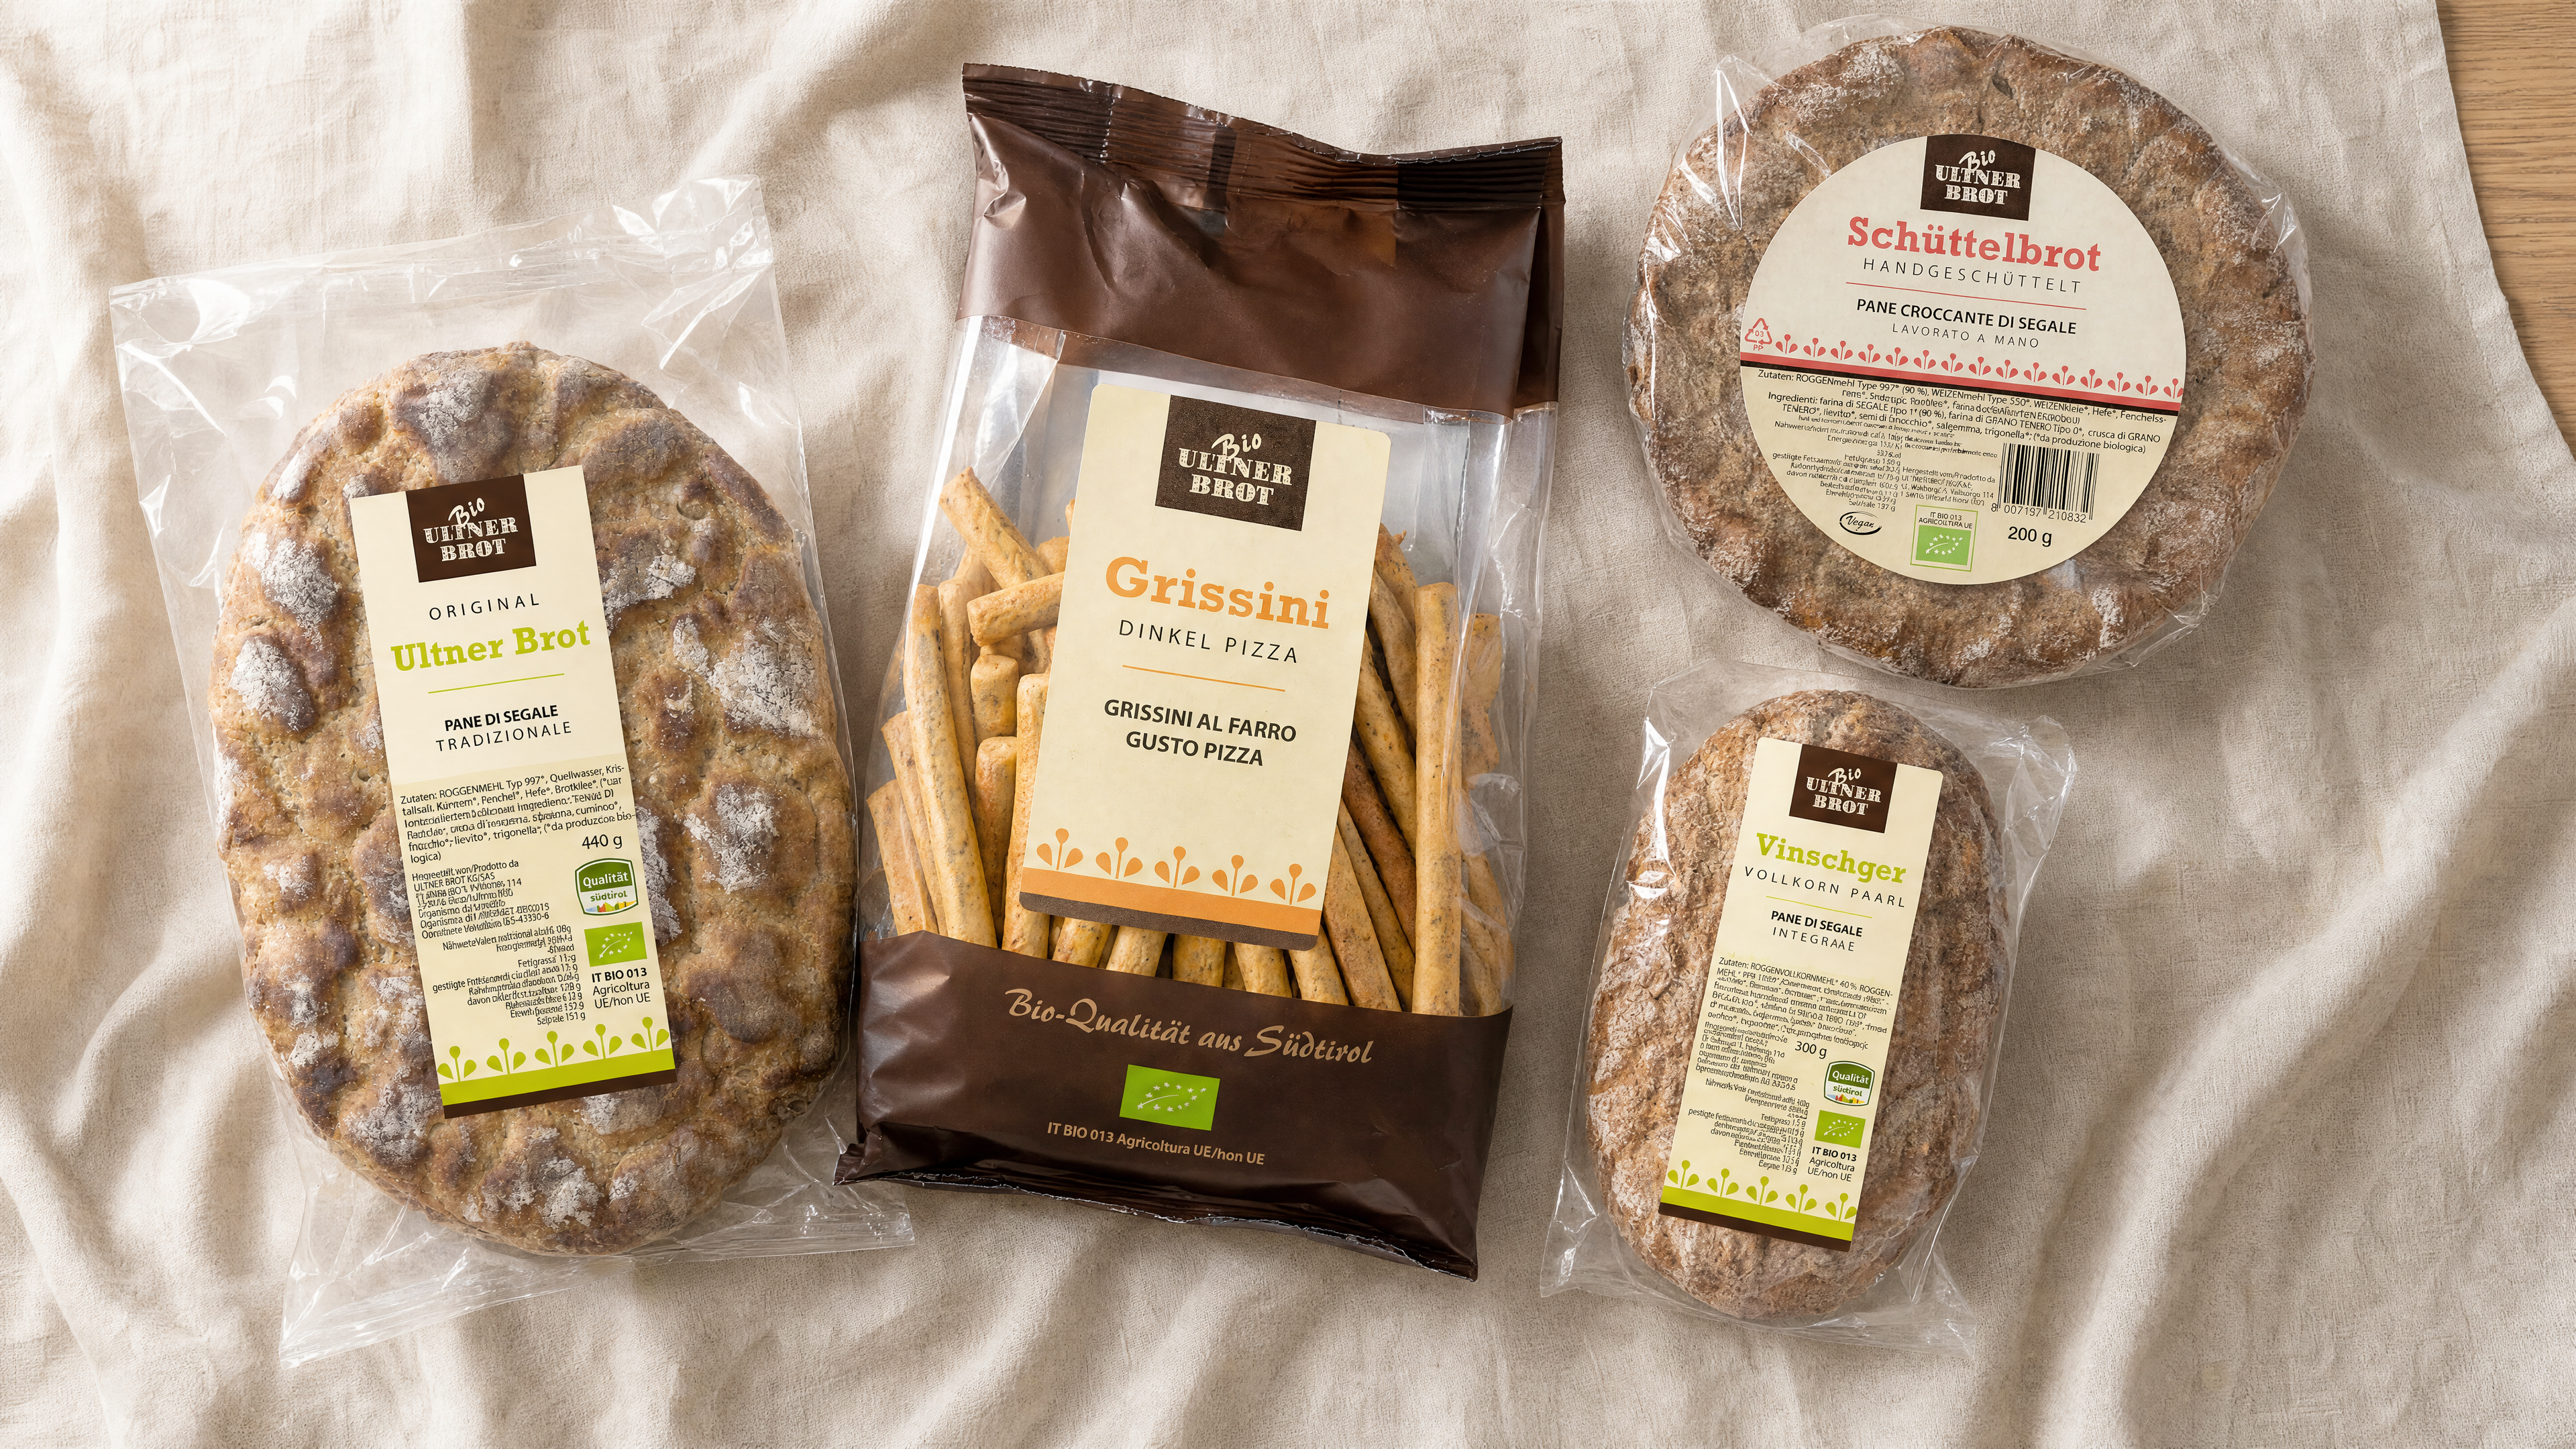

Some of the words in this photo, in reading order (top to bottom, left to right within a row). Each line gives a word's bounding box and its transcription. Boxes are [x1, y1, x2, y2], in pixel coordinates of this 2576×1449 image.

[1959, 150, 1996, 171] Bio
[1935, 164, 2021, 190] ULTNER
[1944, 184, 2008, 205] BROT
[1847, 216, 2101, 272] Schüttelbrot
[1864, 258, 2081, 293] HANDGESCHÜTTELT
[1857, 299, 1897, 315] PANE
[1900, 304, 1994, 327] CROCCANTE
[1998, 315, 2015, 328] DI
[2019, 317, 2077, 335] SEGALE
[1892, 323, 1970, 341] LAVORATO
[1977, 333, 1985, 343] A
[1994, 335, 2039, 348] MANO
[1758, 369, 1794, 381] Zutaten:
[1796, 374, 1855, 387] ROGGENmehl
[1857, 380, 1878, 391] Type
[1931, 388, 1986, 401] WEIZENmehl
[1987, 394, 2007, 405] Type
[1768, 391, 1818, 404] Ingredienti:
[1820, 396, 1843, 407] farina
[1845, 399, 1854, 408] di
[1856, 400, 1888, 411] SEGALE
[1948, 411, 1973, 421] farina
[1975, 415, 1984, 423] di
[2019, 419, 2052, 431] TENERO
[2053, 423, 2071, 435] Tipo
[2088, 430, 2115, 439] crusca
[2117, 431, 2126, 440] di
[2128, 432, 2161, 443] GRANO
[1212, 433, 1262, 460] Bio
[1859, 413, 1878, 421] semi
[1879, 413, 1887, 422] di
[2051, 437, 2101, 449] produzione
[2103, 440, 2146, 454] biologica)
[1179, 447, 1293, 486] ULTNER
[1189, 474, 1275, 506] BROT
[448, 497, 485, 527] Bio
[2048, 509, 2086, 523] 210832
[423, 517, 518, 543] ULTNER
[2008, 526, 2037, 542] 200
[2042, 532, 2052, 547] g
[441, 539, 506, 561] BROT
[1106, 556, 1330, 630] Grissini
[429, 593, 539, 621] ORIGINAL
[390, 639, 504, 672] Ultner
[512, 620, 591, 655] Brot
[1119, 619, 1210, 650] DINKEL
[1225, 637, 1297, 663] PIZZA
[444, 715, 482, 732] PANE
[484, 712, 501, 726] DI
[503, 704, 559, 723] SEGALE
[1104, 699, 1193, 728] GRISSINI
[1196, 713, 1223, 733] AL
[1228, 717, 1297, 742] FARRO
[435, 721, 572, 751] TRADIZIONALE
[1126, 731, 1199, 757] GUSTO
[1203, 742, 1263, 767] PIZZA
[400, 793, 437, 804] Zutaten:
[439, 782, 504, 798] ROGGENMEHL
[505, 780, 523, 791] Typ
[549, 768, 604, 783] Quellwasser,
[606, 764, 625, 774] Kris-
[1828, 767, 1862, 785] Bio
[1806, 777, 1882, 803] ULTNER
[1813, 794, 1868, 816] BROT
[582, 834, 608, 849] 440
[612, 836, 623, 849] g
[410, 851, 441, 865] logica)
[508, 859, 519, 868] da
[1756, 832, 1907, 883] Vinschger
[582, 871, 629, 889] Qualität
[1745, 866, 1839, 894] VOLLKORN
[1850, 888, 1904, 908] PAARL
[1771, 910, 1802, 925] PANE
[1805, 916, 1818, 928] DI
[1819, 920, 1863, 937] SEGALE
[592, 972, 602, 983] IT
[604, 969, 624, 981] BIO
[626, 967, 647, 978] 013
[1719, 957, 1749, 969] Zutaten:
[1859, 984, 1893, 998] ROGGEN-
[467, 996, 491, 1006] davon
[592, 981, 650, 998] Agricoltura
[635, 991, 651, 1003] UE
[1005, 988, 1191, 1044] Bio-Qualität
[1197, 1032, 1242, 1052] aus
[1243, 1025, 1374, 1063] Südtirol
[1794, 1040, 1817, 1055] 300
[1819, 1048, 1827, 1060] g
[1832, 1070, 1869, 1085] Qualität
[1047, 1122, 1062, 1135] IT
[1063, 1124, 1087, 1138] BIO
[1089, 1129, 1114, 1143] 013
[1116, 1133, 1191, 1155] Agricoltura
[1246, 1151, 1265, 1165] UE
[1812, 1146, 1822, 1155] IT
[1822, 1148, 1839, 1158] BIO
[1840, 1152, 1857, 1162] 013
[1809, 1157, 1855, 1172] Agricoltura
[1840, 1172, 1852, 1182] UE
